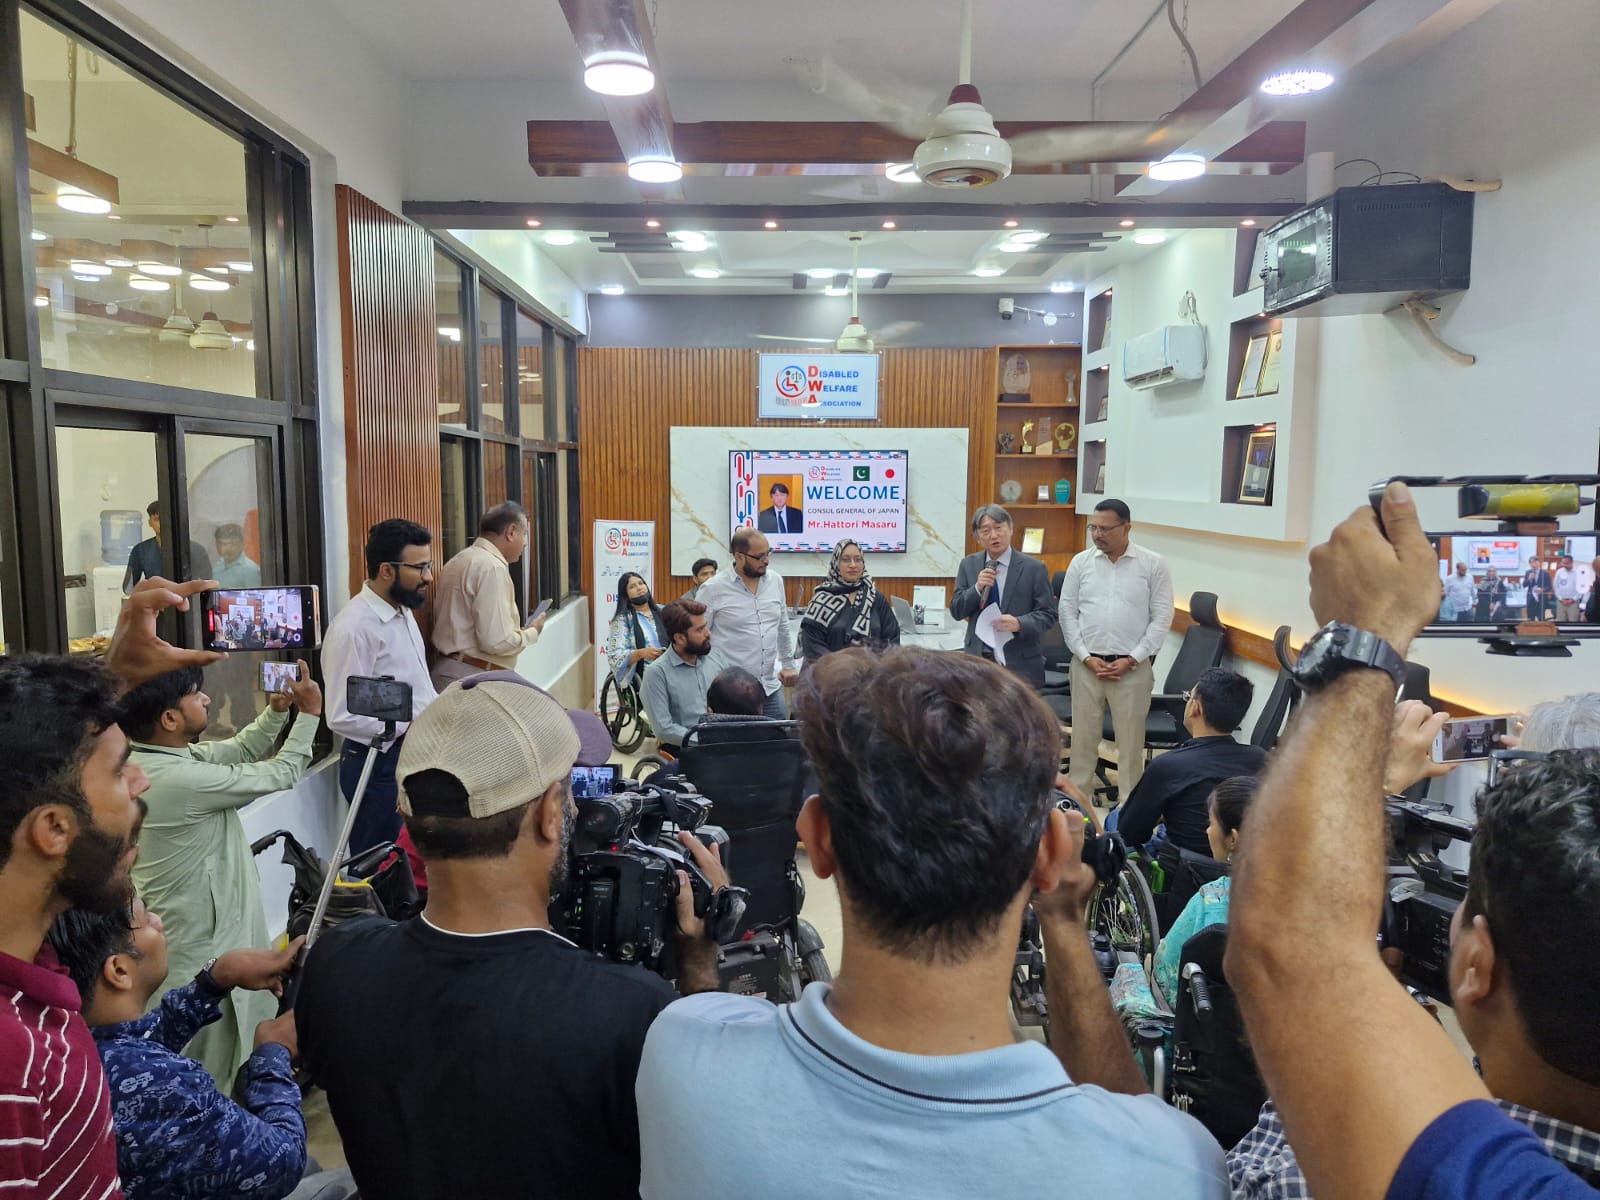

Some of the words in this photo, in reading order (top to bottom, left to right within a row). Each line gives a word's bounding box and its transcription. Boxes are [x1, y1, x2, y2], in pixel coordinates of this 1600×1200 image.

[808, 366, 859, 378] DISABLED
[808, 380, 858, 393] WELFARE
[807, 486, 899, 500] WELCOME
[808, 520, 858, 529] Mr.Hattori
[861, 520, 897, 529] Masaru
